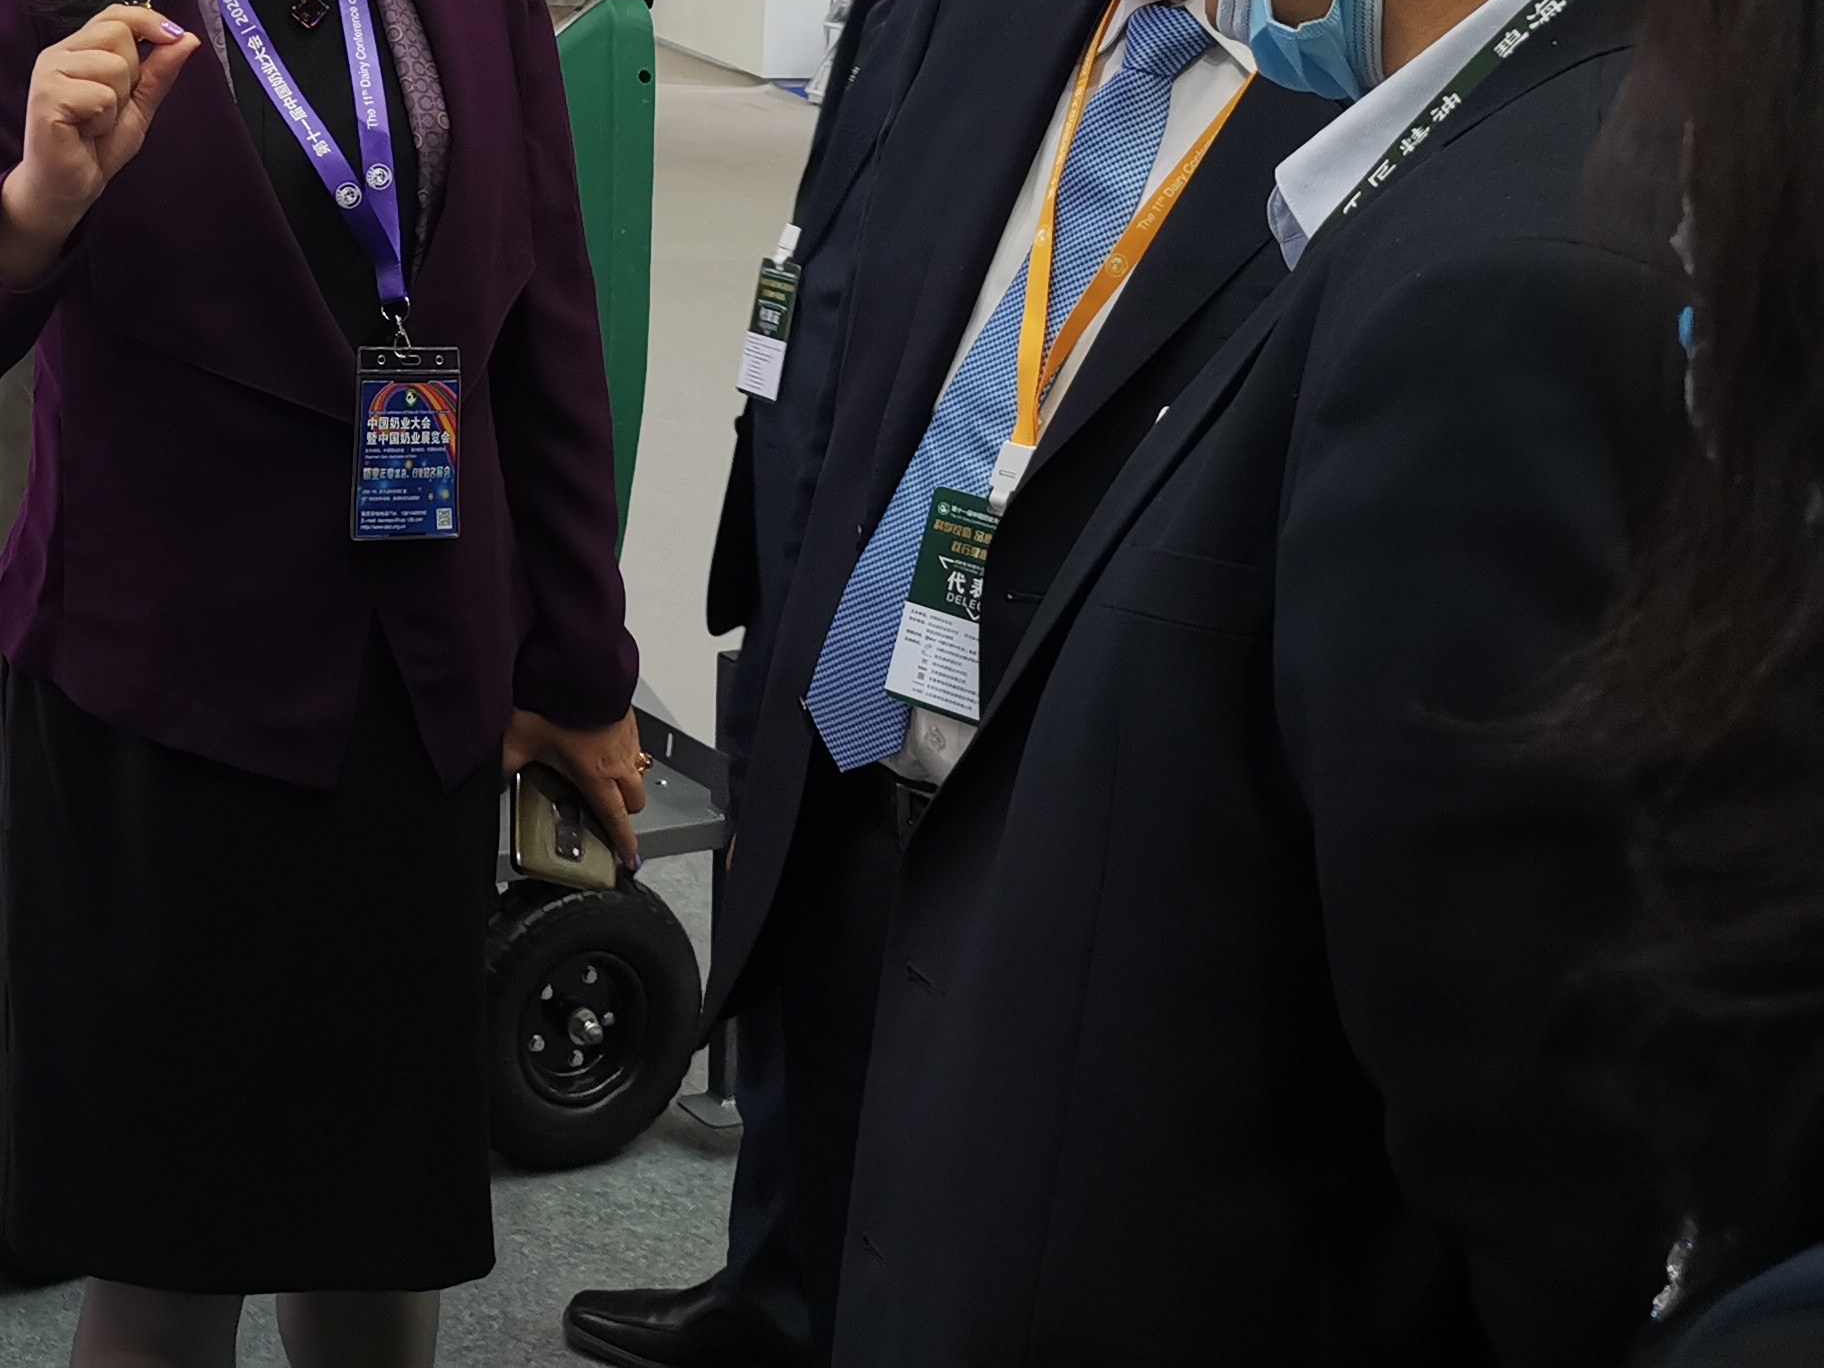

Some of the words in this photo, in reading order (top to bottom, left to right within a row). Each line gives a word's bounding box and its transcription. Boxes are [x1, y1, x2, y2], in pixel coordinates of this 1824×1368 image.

[348, 7, 367, 61] Conference
[359, 62, 372, 88] Dairy
[245, 38, 333, 158] 第十一届中国奶业大会
[366, 108, 378, 130] The
[367, 416, 431, 430] 中国奶业大会
[366, 430, 451, 446] 暨中国奶业展览会
